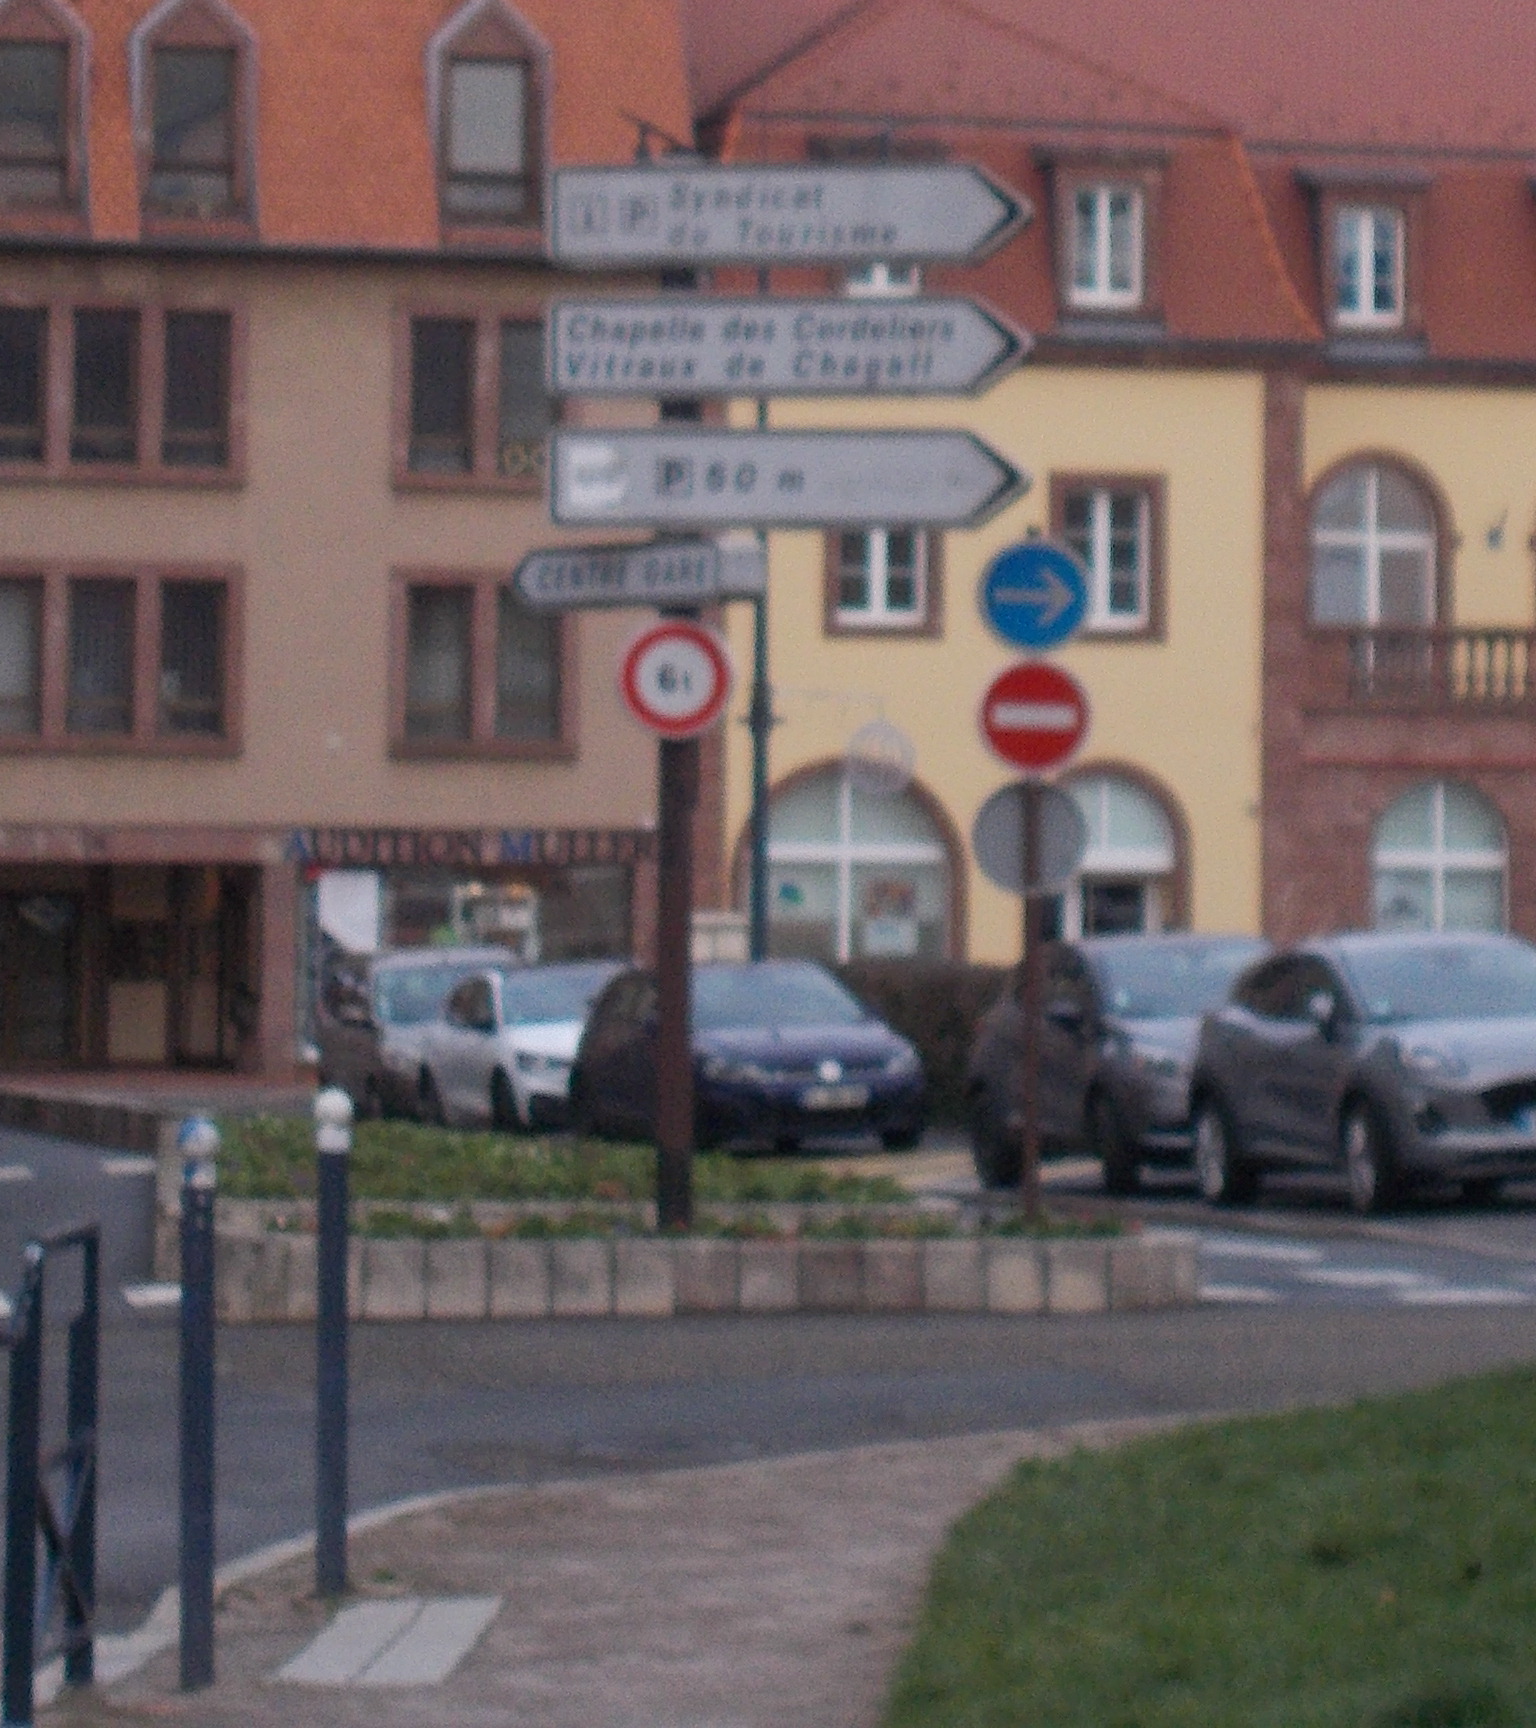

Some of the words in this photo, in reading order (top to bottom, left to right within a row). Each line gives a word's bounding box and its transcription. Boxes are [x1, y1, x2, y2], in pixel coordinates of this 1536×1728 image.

[669, 181, 825, 217] Syndicat
[668, 221, 710, 249] de
[738, 221, 898, 250] Tourisme
[566, 312, 705, 348] Chapelle
[721, 313, 776, 343] des
[723, 351, 766, 379] de
